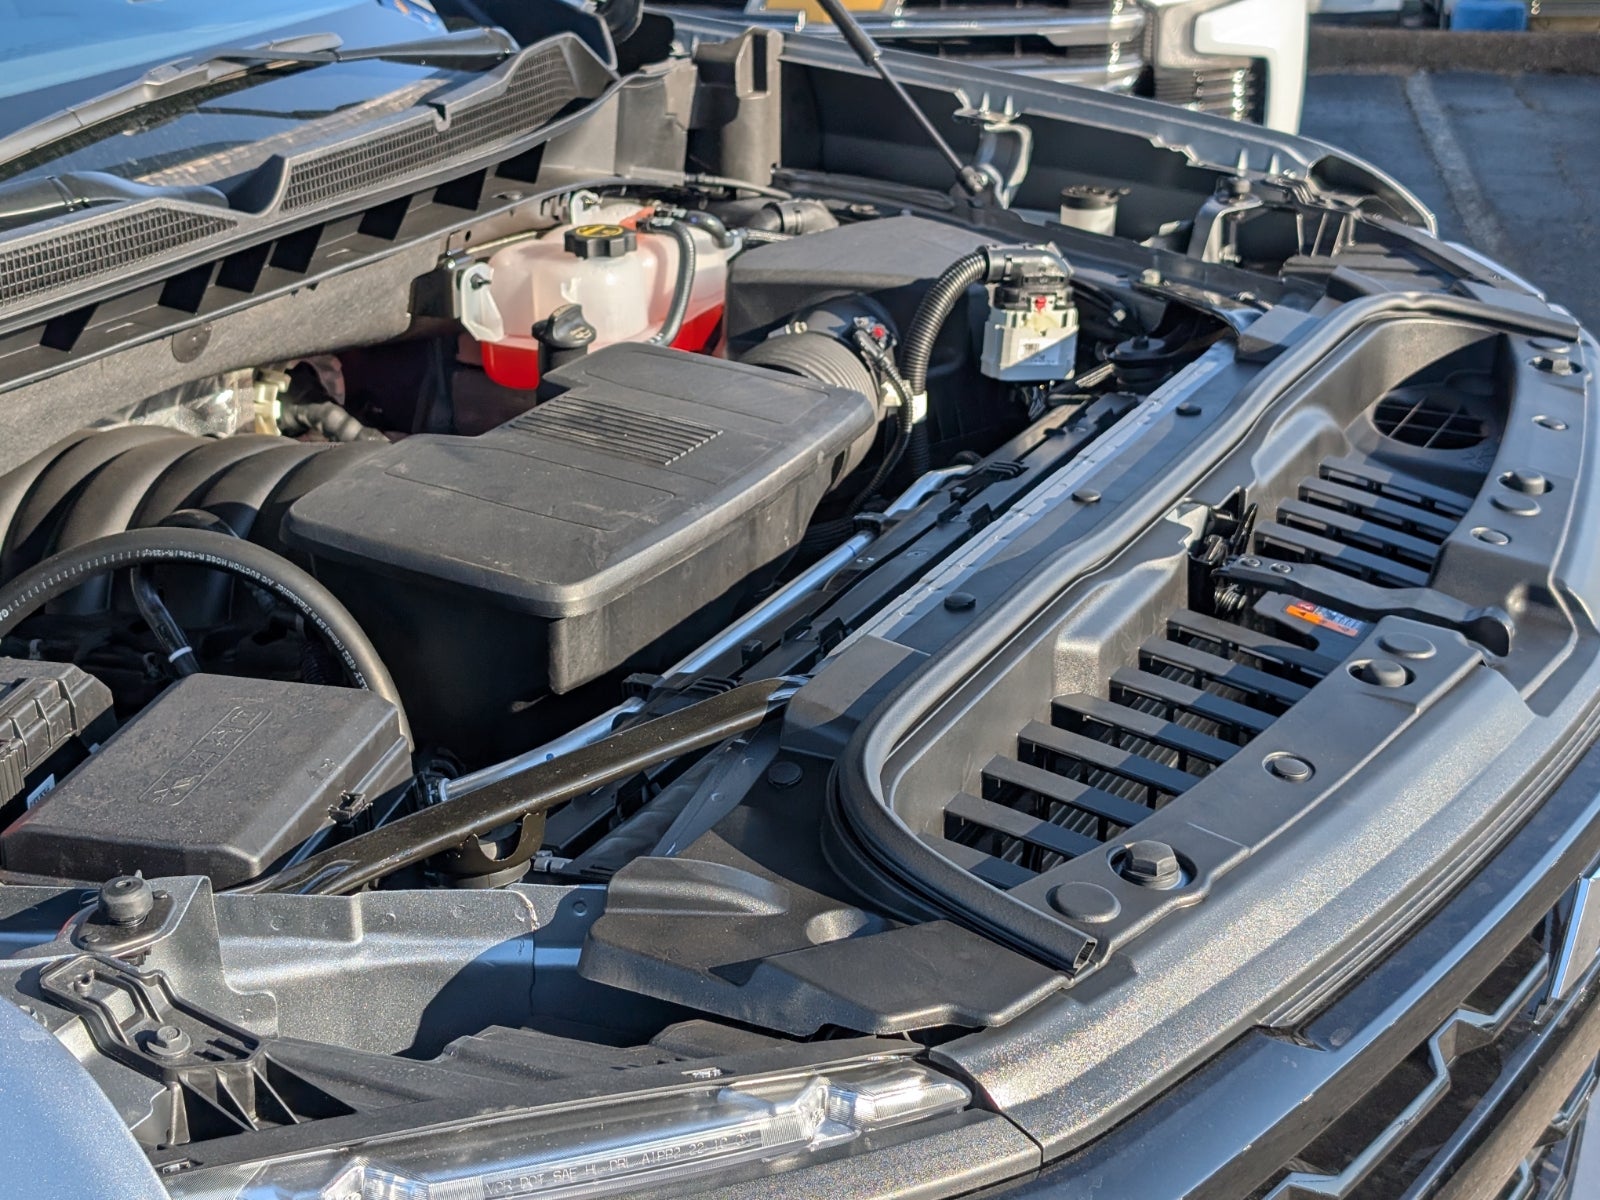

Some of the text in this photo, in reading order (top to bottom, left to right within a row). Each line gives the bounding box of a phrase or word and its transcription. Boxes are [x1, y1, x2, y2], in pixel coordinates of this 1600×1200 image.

[206, 553, 228, 567] HOSE
[228, 560, 261, 580] SUCTION
[260, 575, 275, 586] A/C
[519, 1173, 545, 1190] DOT
[552, 1167, 578, 1183] SAE
[688, 1141, 705, 1156] 22
